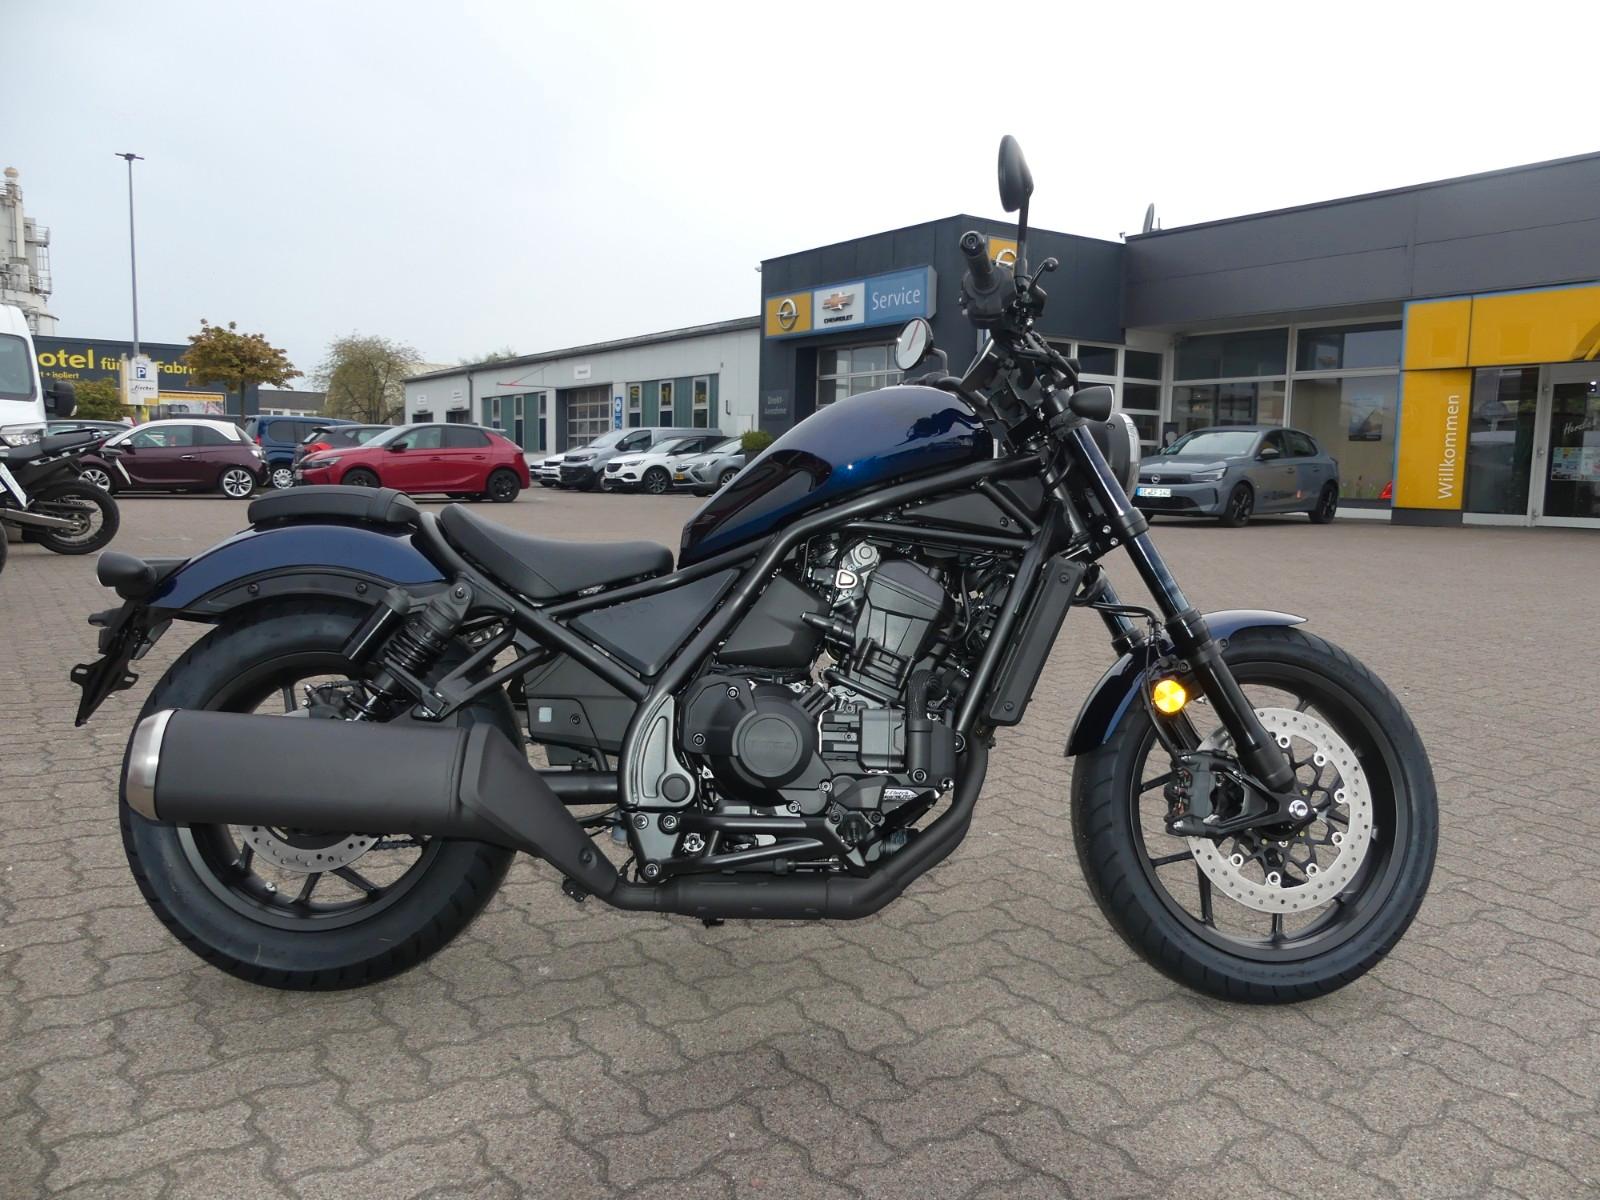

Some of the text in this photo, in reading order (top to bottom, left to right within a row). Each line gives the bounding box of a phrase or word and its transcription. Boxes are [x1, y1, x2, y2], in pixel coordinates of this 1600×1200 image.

[872, 286, 921, 311] Service
[824, 314, 853, 324] CHEVROLET
[1437, 394, 1460, 499] Willkommen
